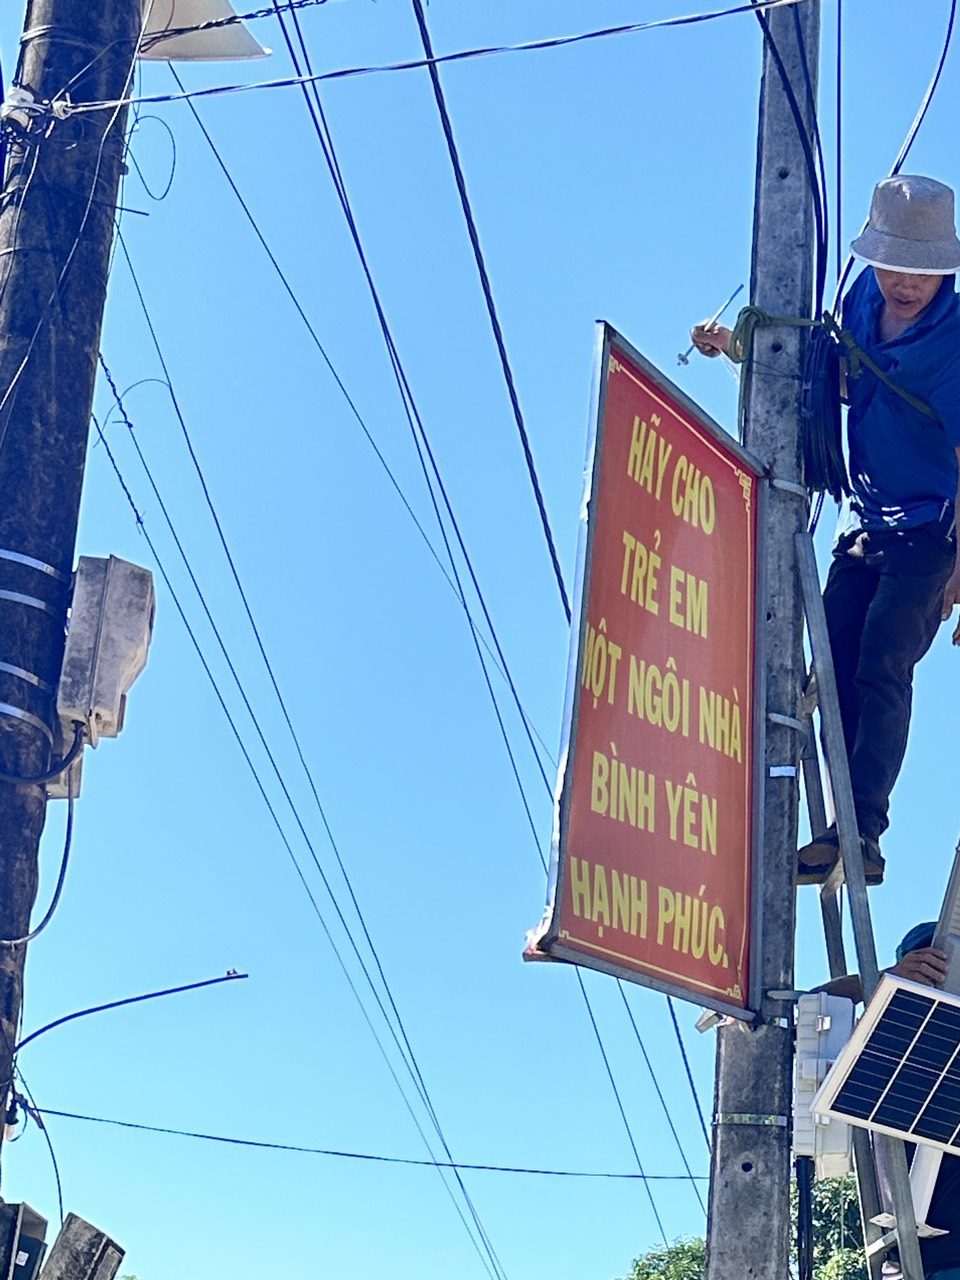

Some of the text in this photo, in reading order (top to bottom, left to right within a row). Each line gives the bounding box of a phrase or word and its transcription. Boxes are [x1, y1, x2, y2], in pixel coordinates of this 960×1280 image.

[627, 413, 715, 535] HÃY CHO
[621, 529, 708, 639] TRẺ EM
[627, 656, 689, 737] NGÔI
[699, 686, 742, 764] NHÀ
[591, 741, 717, 855] BÌNH YÊN
[570, 856, 729, 968] HẠNH PHÚC.
